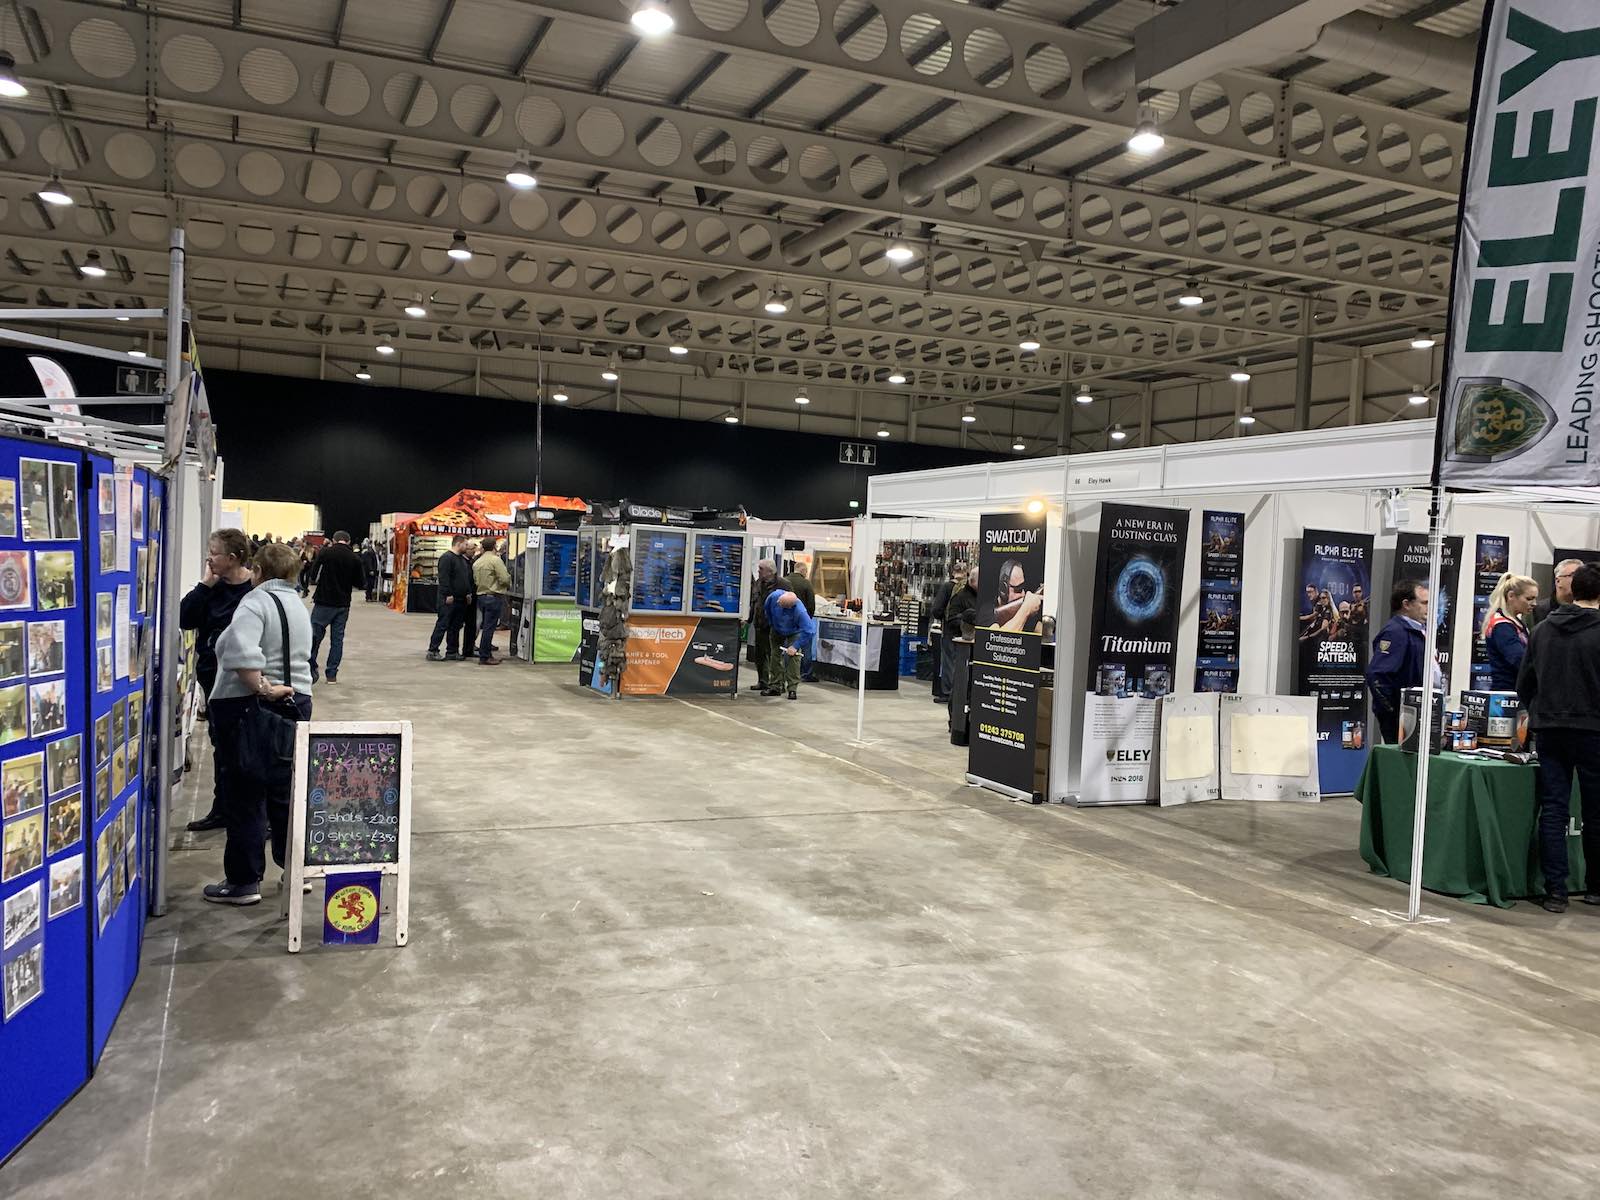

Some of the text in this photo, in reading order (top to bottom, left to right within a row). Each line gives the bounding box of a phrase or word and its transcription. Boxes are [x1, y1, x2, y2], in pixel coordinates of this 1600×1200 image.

[1465, 7, 1600, 352] ELEY
[1566, 353, 1598, 464] LEADING
[631, 501, 662, 514] blade
[1116, 518, 1174, 531] A NEW ERA IN
[985, 529, 1037, 543] SWATCOM
[1111, 529, 1178, 543] DUSTING CLAYS
[1314, 544, 1364, 559] ALPHA ELITE
[1407, 545, 1413, 553] A
[1403, 555, 1454, 566] DUSTIN LAYS
[661, 625, 684, 639] tech
[990, 633, 1023, 646] Professional
[1102, 636, 1172, 654] Titanium
[985, 642, 1026, 656] Communication
[1319, 641, 1355, 653] SPEED &
[992, 652, 1018, 665] Solutions
[1317, 652, 1357, 663] PATTERN
[1468, 696, 1486, 704] ELEY
[1500, 700, 1520, 708] ELEY
[980, 722, 1000, 736] 01243
[1317, 732, 1330, 741] LEY
[317, 742, 397, 757] PAY HERE
[1117, 749, 1151, 761] ELEY
[311, 810, 328, 826] 5
[328, 811, 363, 823] shots
[309, 829, 325, 844] 10
[327, 830, 363, 842] shots
